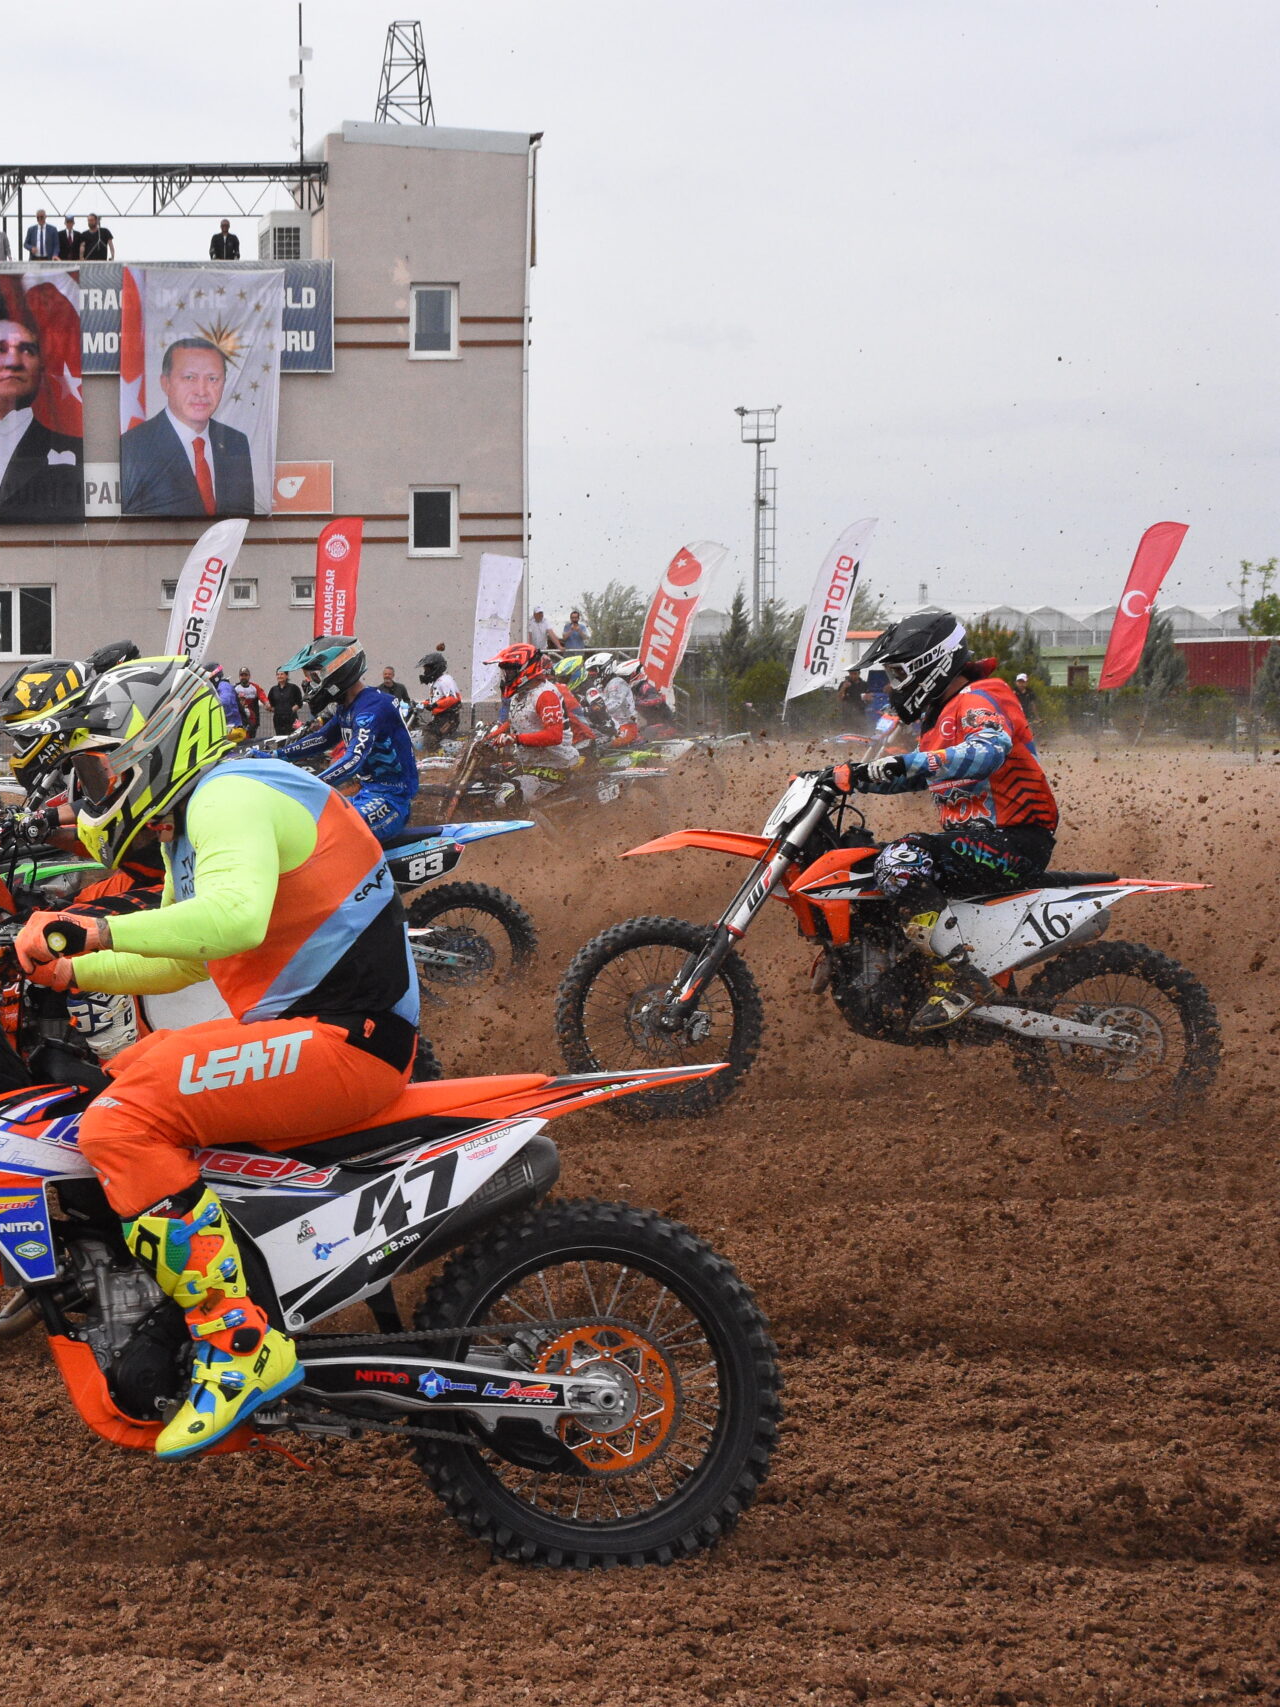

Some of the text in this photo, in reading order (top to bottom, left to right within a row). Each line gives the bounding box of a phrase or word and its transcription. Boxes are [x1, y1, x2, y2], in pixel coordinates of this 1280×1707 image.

[191, 556, 224, 614] TOTO
[644, 597, 683, 674] TMF
[810, 555, 854, 676] SPOR TOTO
[408, 852, 444, 881] 83
[820, 887, 863, 898] KTM
[1022, 908, 1073, 951] 16
[178, 1029, 314, 1096] LEATT
[353, 1150, 460, 1238] 47
[0, 1220, 45, 1234] NITRO
[355, 1369, 411, 1385] NITRO
